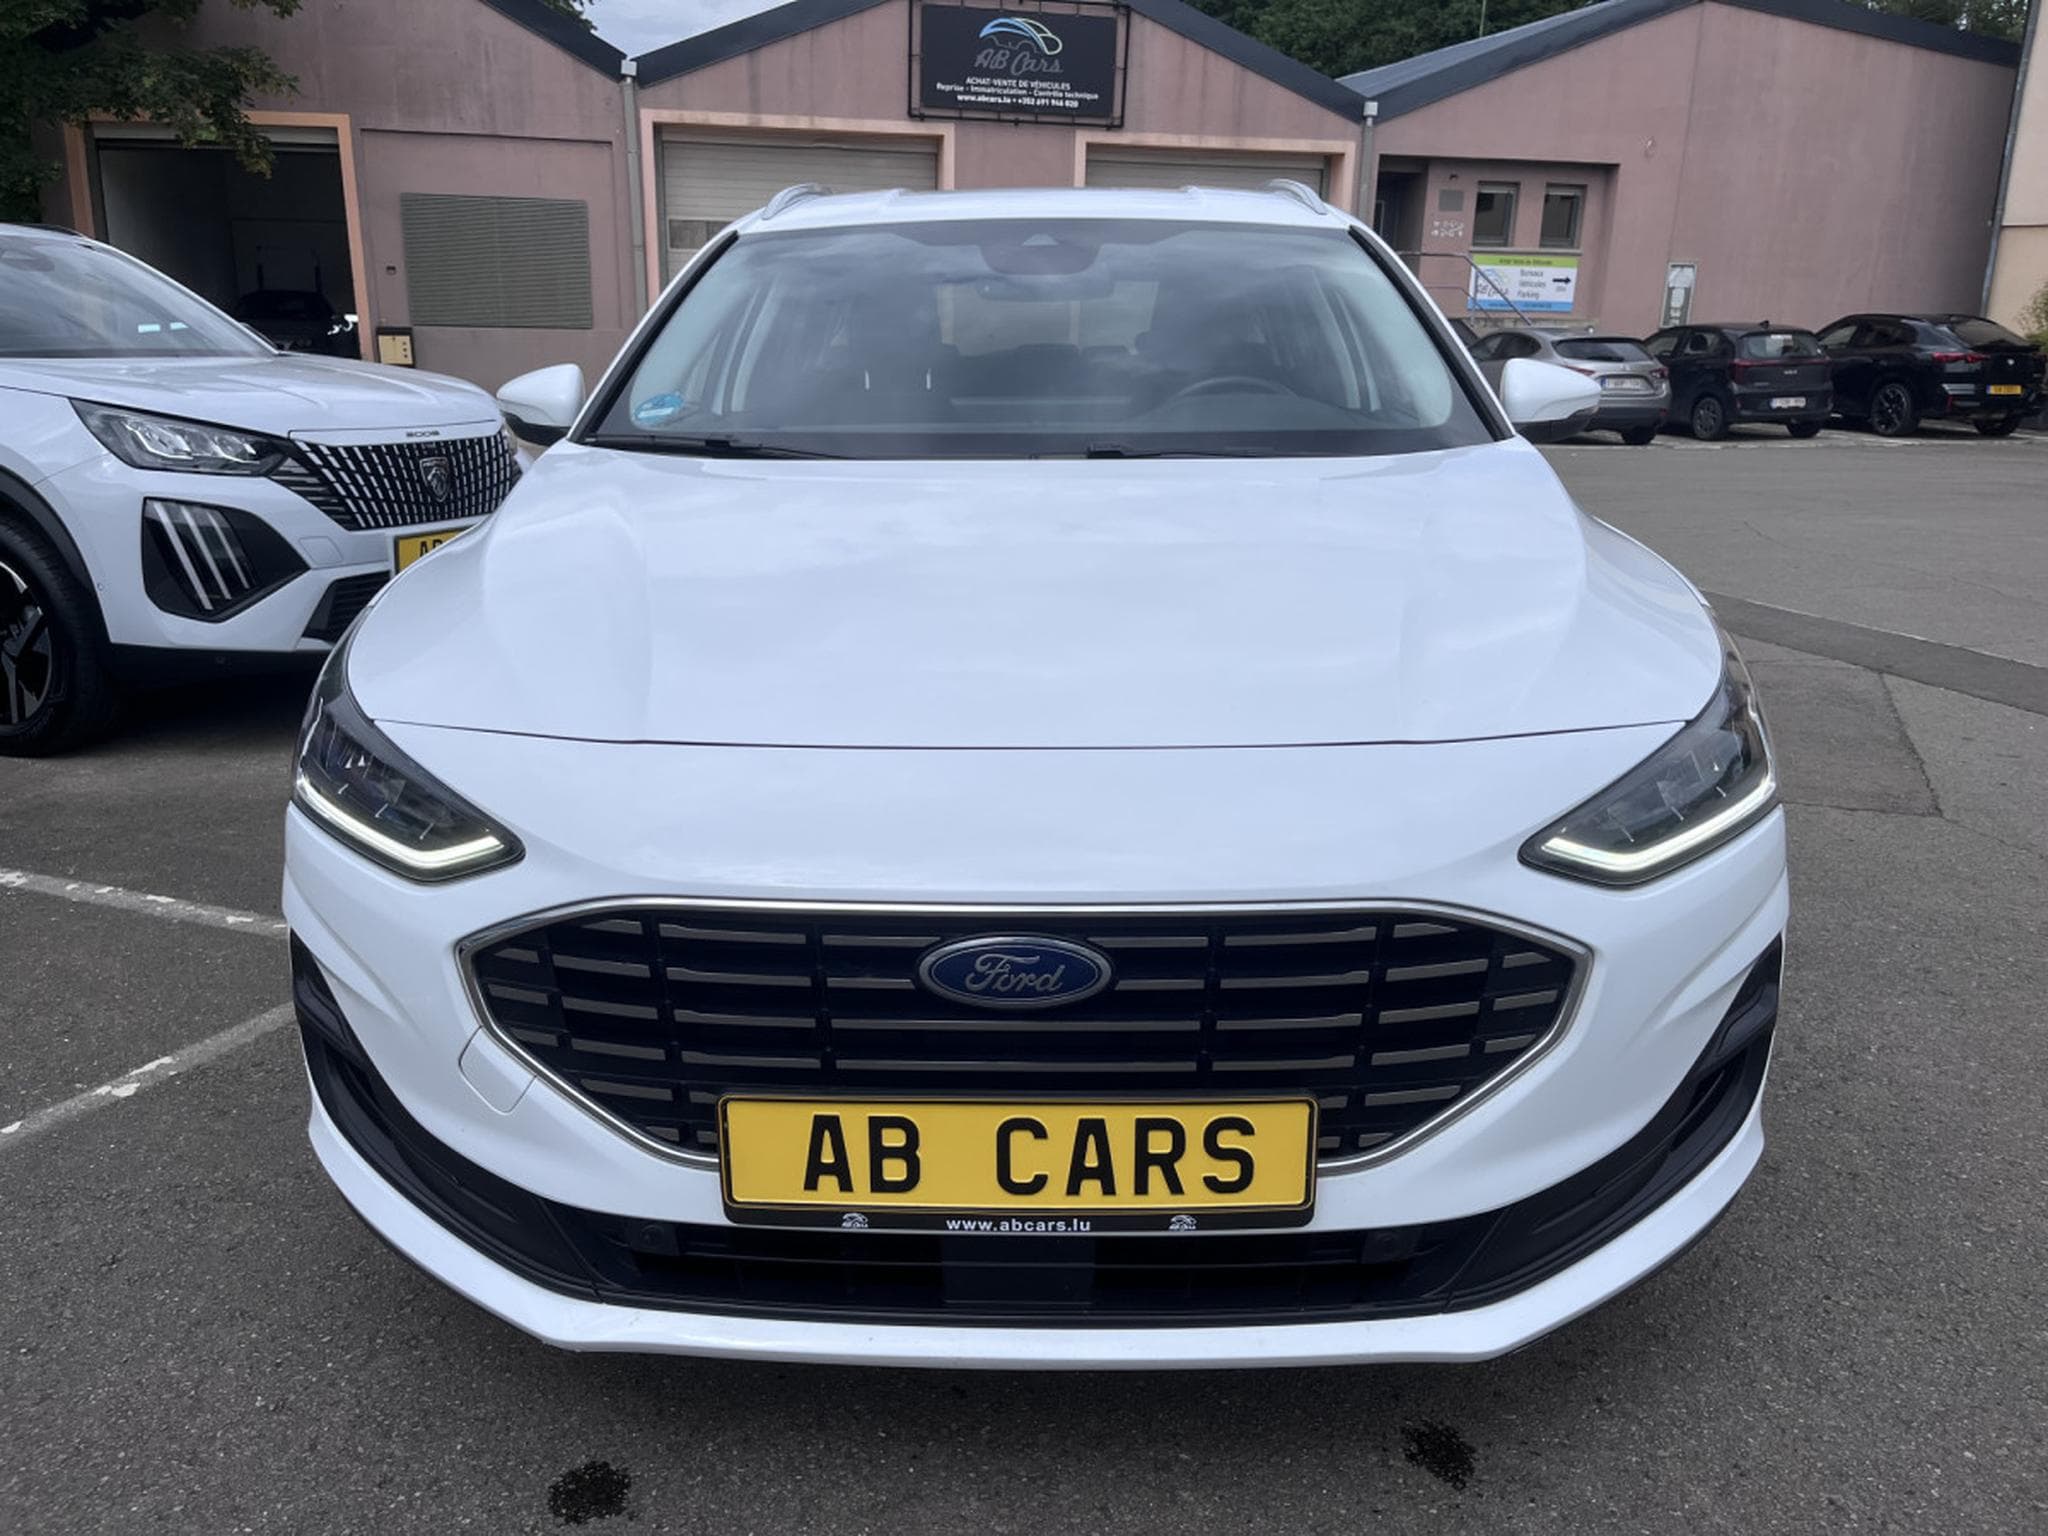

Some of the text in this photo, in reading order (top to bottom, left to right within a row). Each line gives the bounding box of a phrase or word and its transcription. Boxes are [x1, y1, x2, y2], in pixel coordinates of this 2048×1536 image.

[974, 48, 1064, 76] AB Cars
[1018, 80, 1028, 88] DE
[964, 952, 1062, 993] Ford
[803, 1113, 1256, 1197] AB CARS
[946, 1217, 1091, 1232] www.abcars.lu
